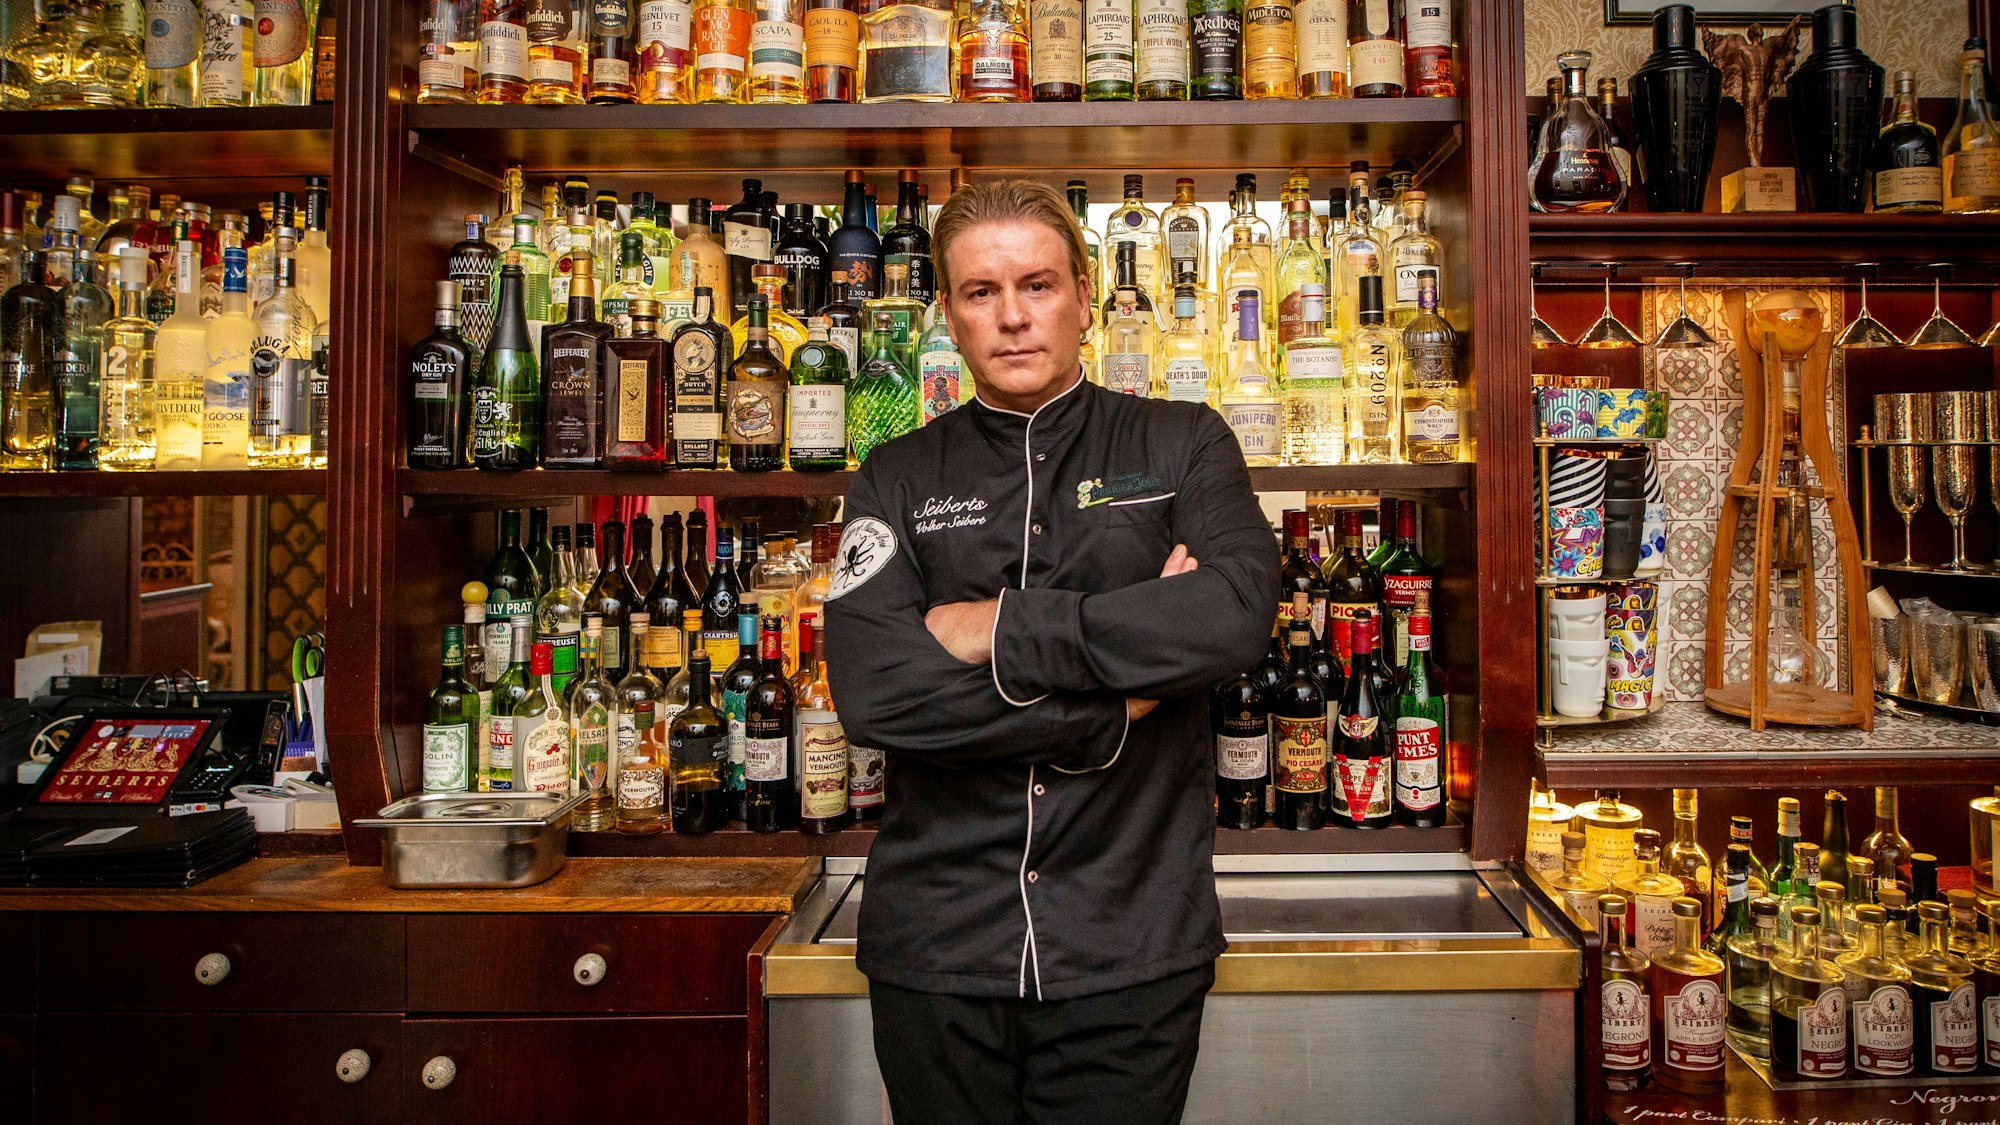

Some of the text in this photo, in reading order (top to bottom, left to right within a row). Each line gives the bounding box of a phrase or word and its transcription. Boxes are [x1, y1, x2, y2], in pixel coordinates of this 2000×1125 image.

[525, 10, 566, 25] enfiddich
[701, 9, 730, 20] GLEN
[1247, 8, 1292, 20] MIDLETON
[1425, 8, 1436, 16] 15
[641, 12, 681, 24] GLENLIVET
[809, 18, 849, 27] CAOL ILA
[1088, 13, 1130, 25] LAPHROAIG
[652, 21, 662, 31] 15
[710, 20, 731, 30] MO
[701, 30, 723, 41] RAN
[755, 25, 792, 37] SCAPA
[823, 27, 831, 35] 18
[1103, 32, 1114, 42] 25
[1316, 29, 1329, 45] 14
[709, 40, 728, 51] GIE
[1143, 38, 1183, 48] TRIPLE WOOD
[975, 61, 1011, 69] DALMORE
[774, 255, 820, 265] BULLDOG
[911, 259, 921, 288] 季の美
[249, 335, 291, 356] BELUGA
[553, 348, 590, 359] BEEFEATER
[1291, 355, 1338, 364] THE BOTANIST
[411, 362, 456, 373] NOLET'S
[622, 361, 646, 370] BEEFEATER
[1165, 370, 1208, 380] DEATH'S DOOR
[552, 380, 591, 390] CROWN
[1370, 371, 1386, 405] 209
[209, 412, 245, 422] GOOSE
[791, 405, 840, 419] Tanqueray
[1230, 413, 1277, 426] JUNIPERO
[794, 431, 835, 442] English Gin
[1244, 434, 1265, 447] GIN
[1091, 482, 1134, 499] PERRIER
[913, 495, 989, 519] Seiberts
[915, 515, 988, 535] Volker Seibert
[1383, 576, 1433, 590] YZAGUIRRE
[485, 601, 532, 616] ILLY PRAT
[703, 631, 738, 640] CHARTREU
[1609, 676, 1654, 693] MAGIC
[762, 721, 780, 729] BYASS
[1396, 732, 1431, 746] PUNT
[807, 751, 846, 763] MANCINO
[1227, 750, 1258, 759] VERMOUTH
[1287, 746, 1322, 757] VERMOUTH
[1403, 745, 1438, 758] MES
[808, 761, 847, 771] VERMOUTH
[1286, 758, 1323, 767] PIO CESARE
[56, 775, 169, 786] SEIBERTS
[624, 786, 655, 794] VERMOUTH
[1595, 852, 1632, 864] Brooklyn
[1864, 1022, 1911, 1033] SEIBERT
[1675, 1034, 1697, 1042] APPLE
[1885, 1032, 1902, 1040] DON
[1623, 1105, 1638, 1114] 1
[1632, 1109, 1688, 1122] part
[1691, 1110, 1787, 1125] Campari
